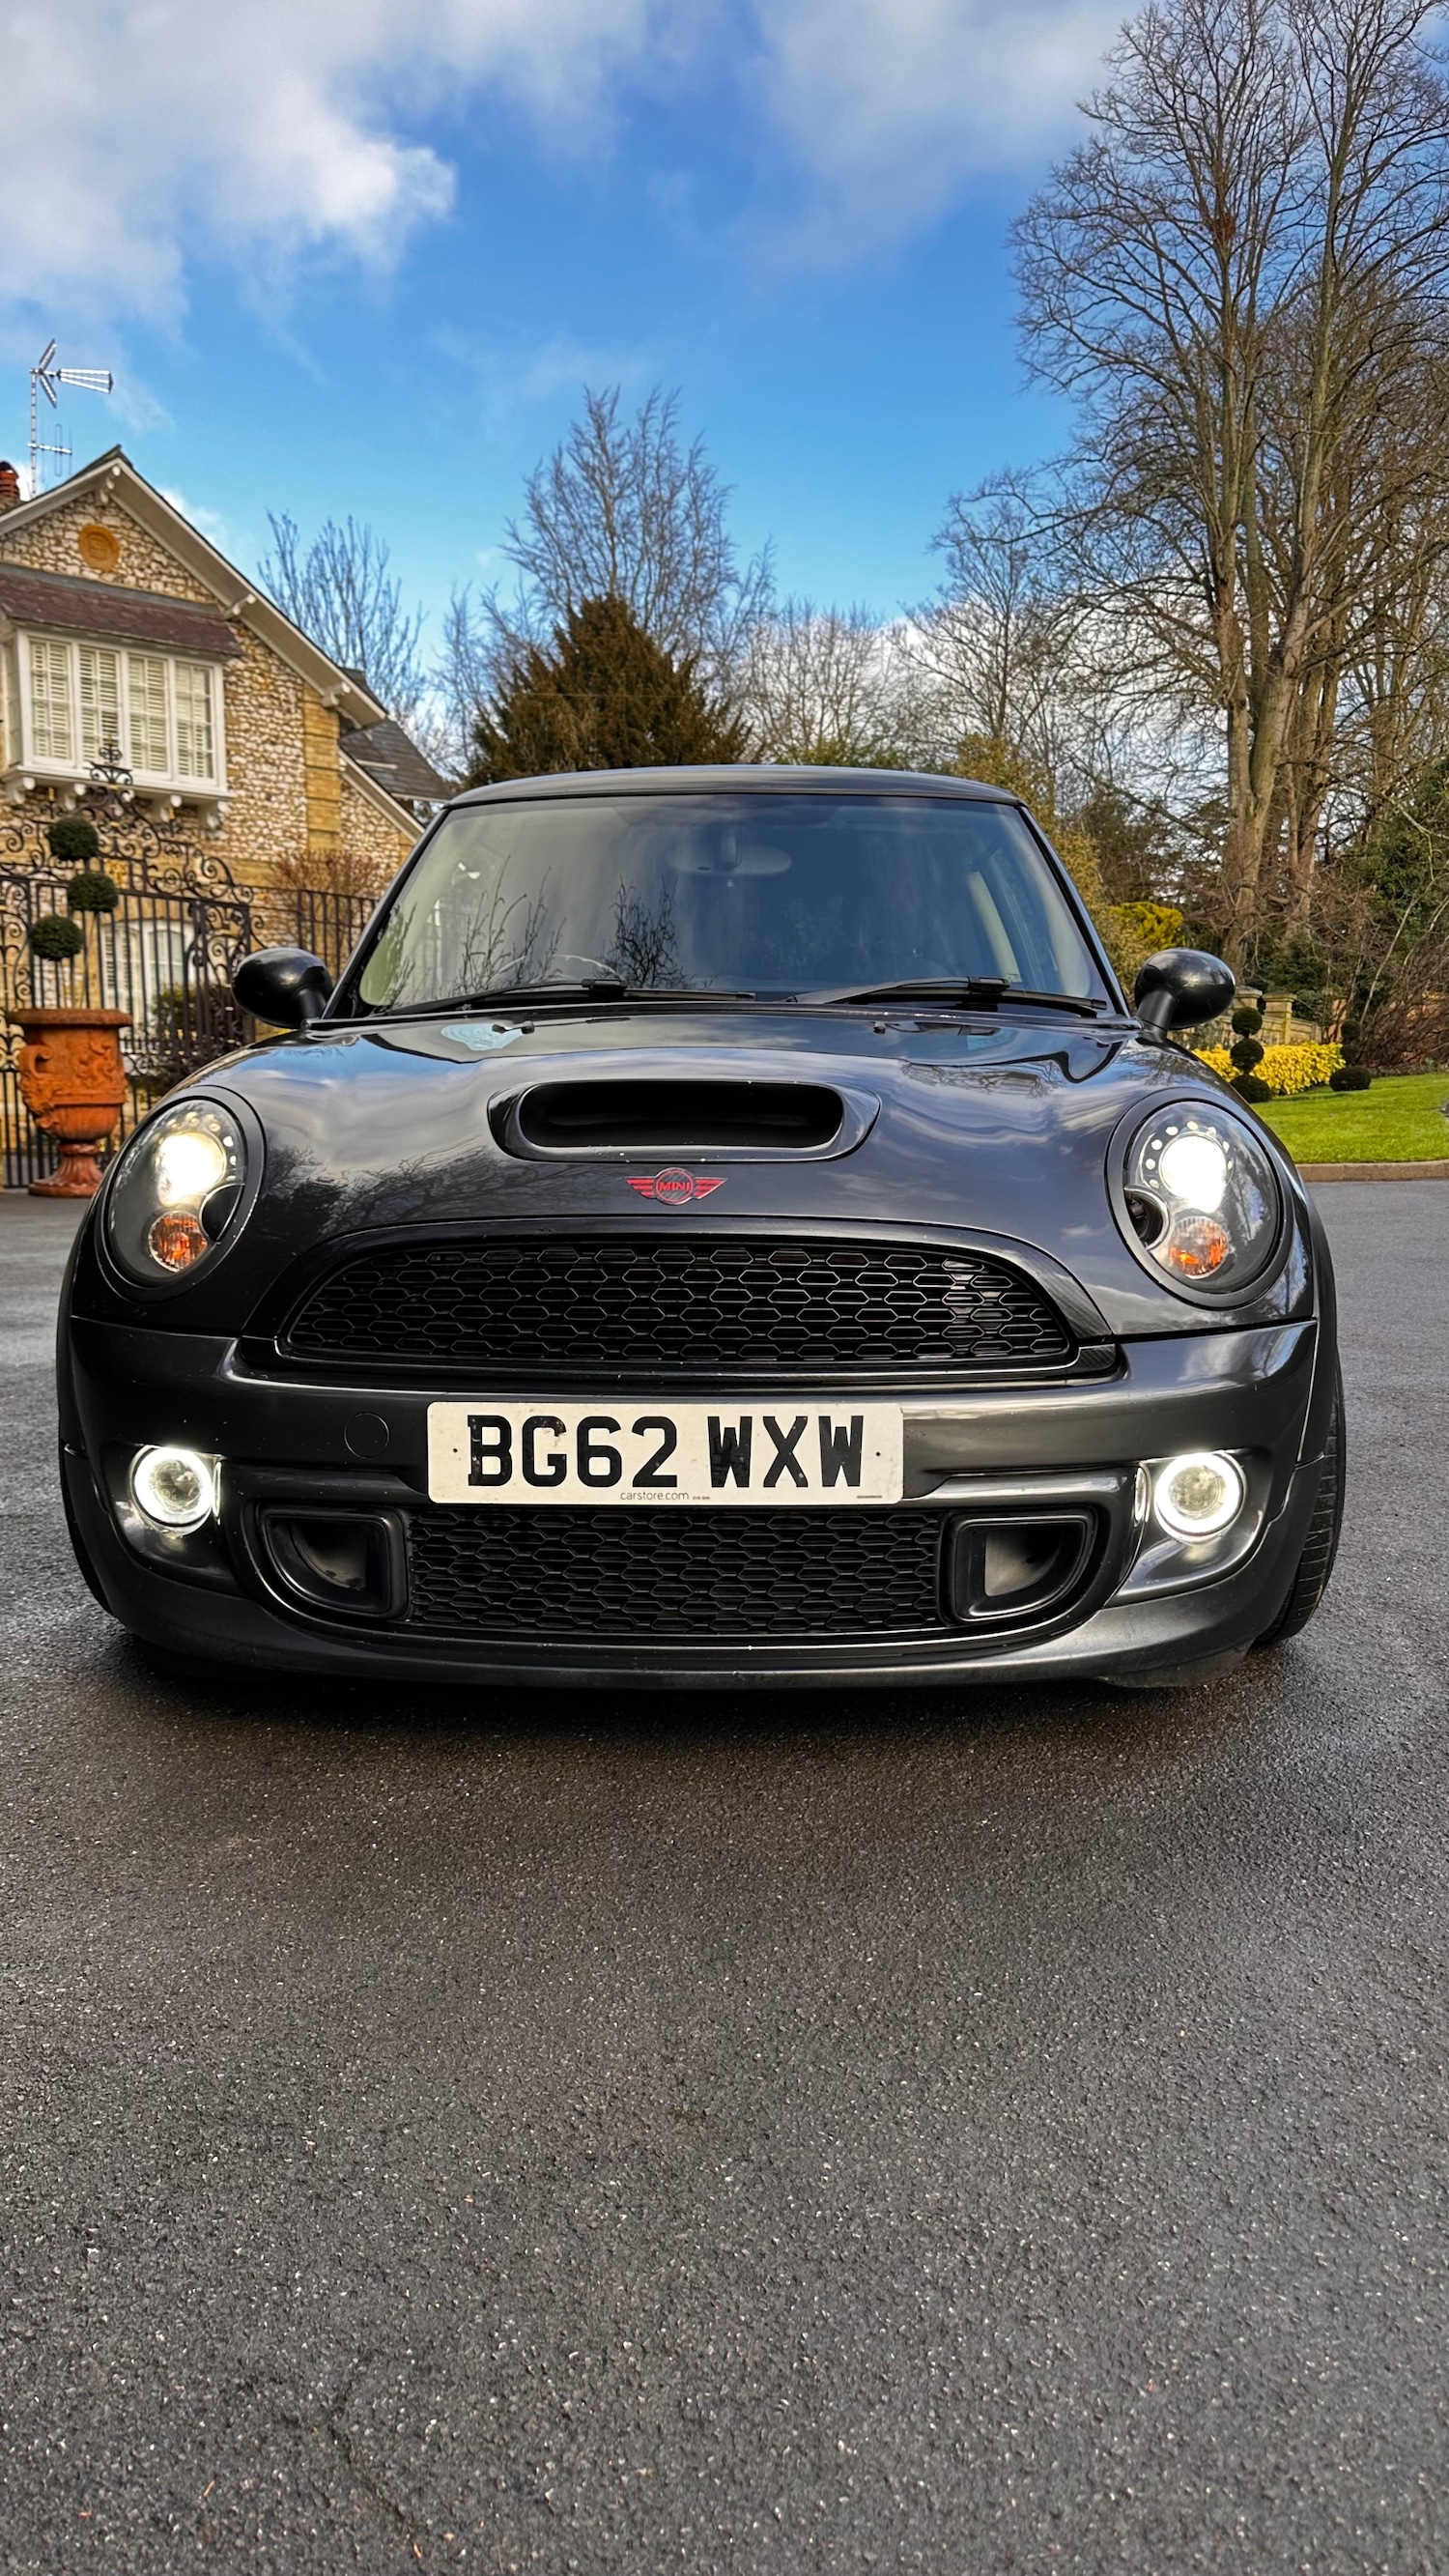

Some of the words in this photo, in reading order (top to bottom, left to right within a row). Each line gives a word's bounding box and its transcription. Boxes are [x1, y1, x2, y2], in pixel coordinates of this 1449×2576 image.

[660, 1182, 691, 1191] MINI
[468, 1415, 677, 1488] BG62
[707, 1415, 864, 1488] WXW
[620, 1491, 689, 1501] carstore.com
